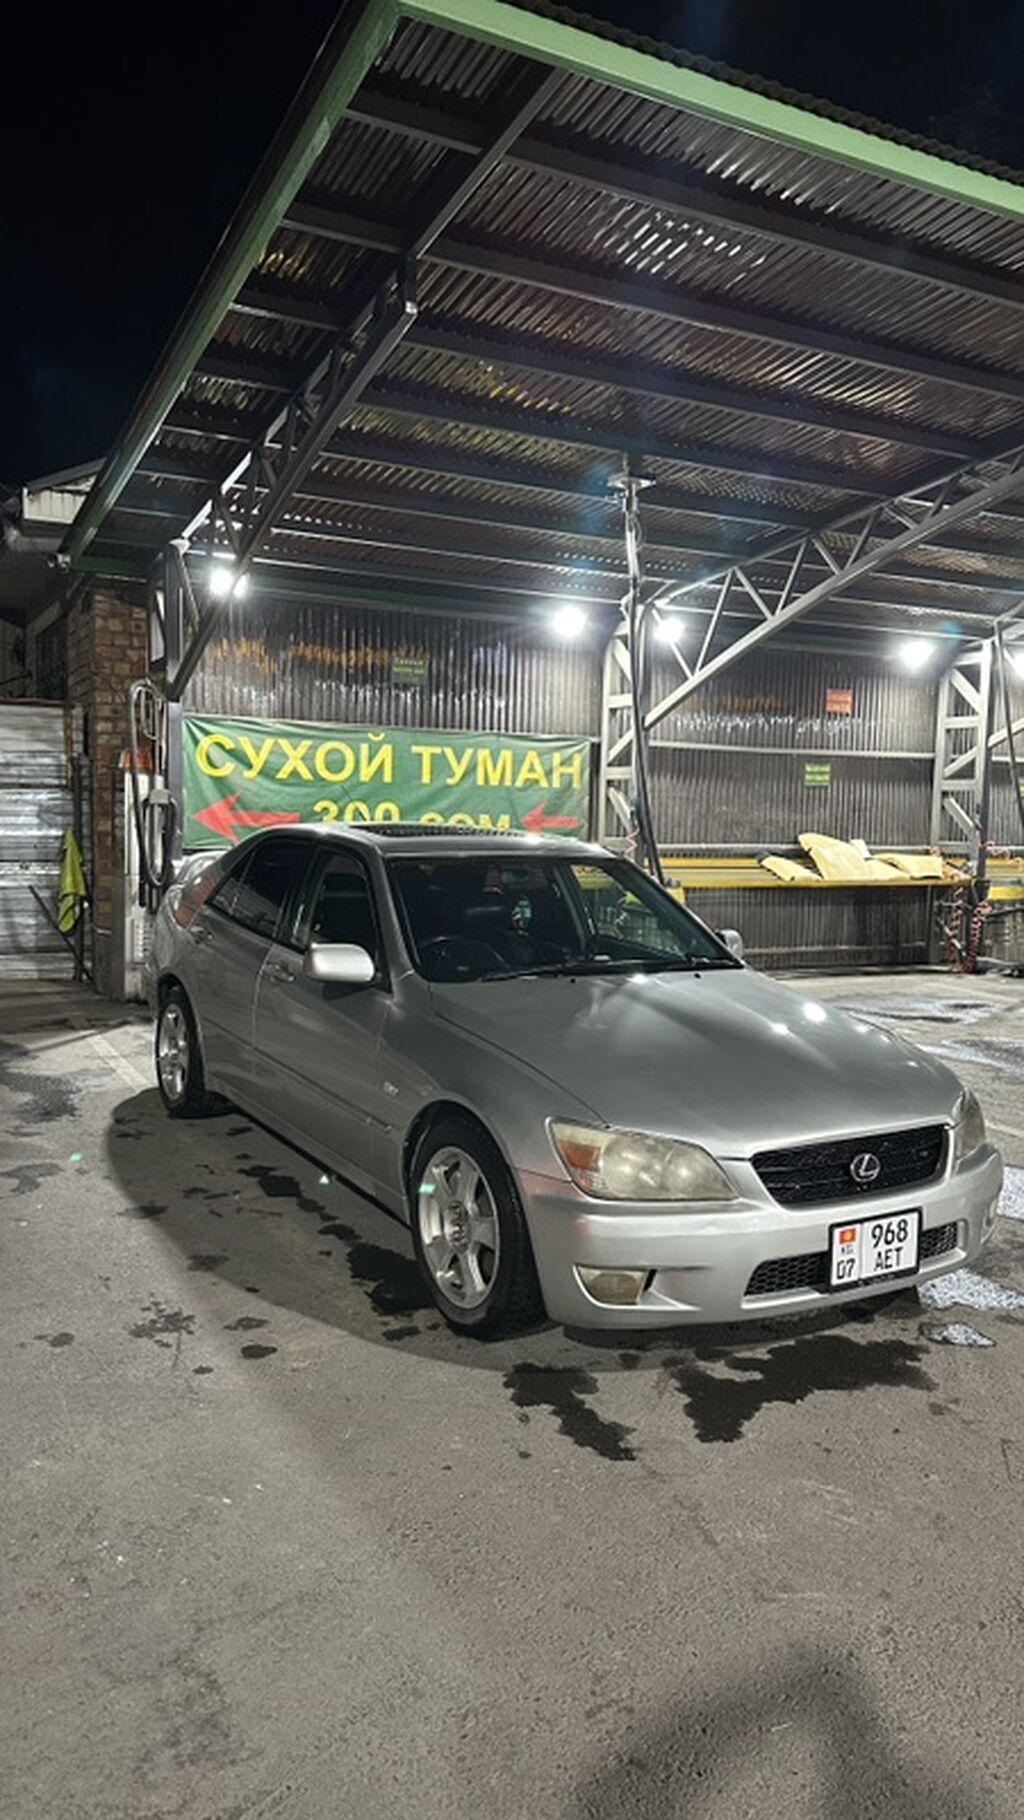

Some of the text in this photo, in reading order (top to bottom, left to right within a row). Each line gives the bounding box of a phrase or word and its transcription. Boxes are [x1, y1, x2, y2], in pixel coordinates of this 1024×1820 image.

[195, 732, 583, 789] СУХОЙ ТУМАН
[871, 1218, 908, 1248] 968
[836, 1258, 855, 1280] 07
